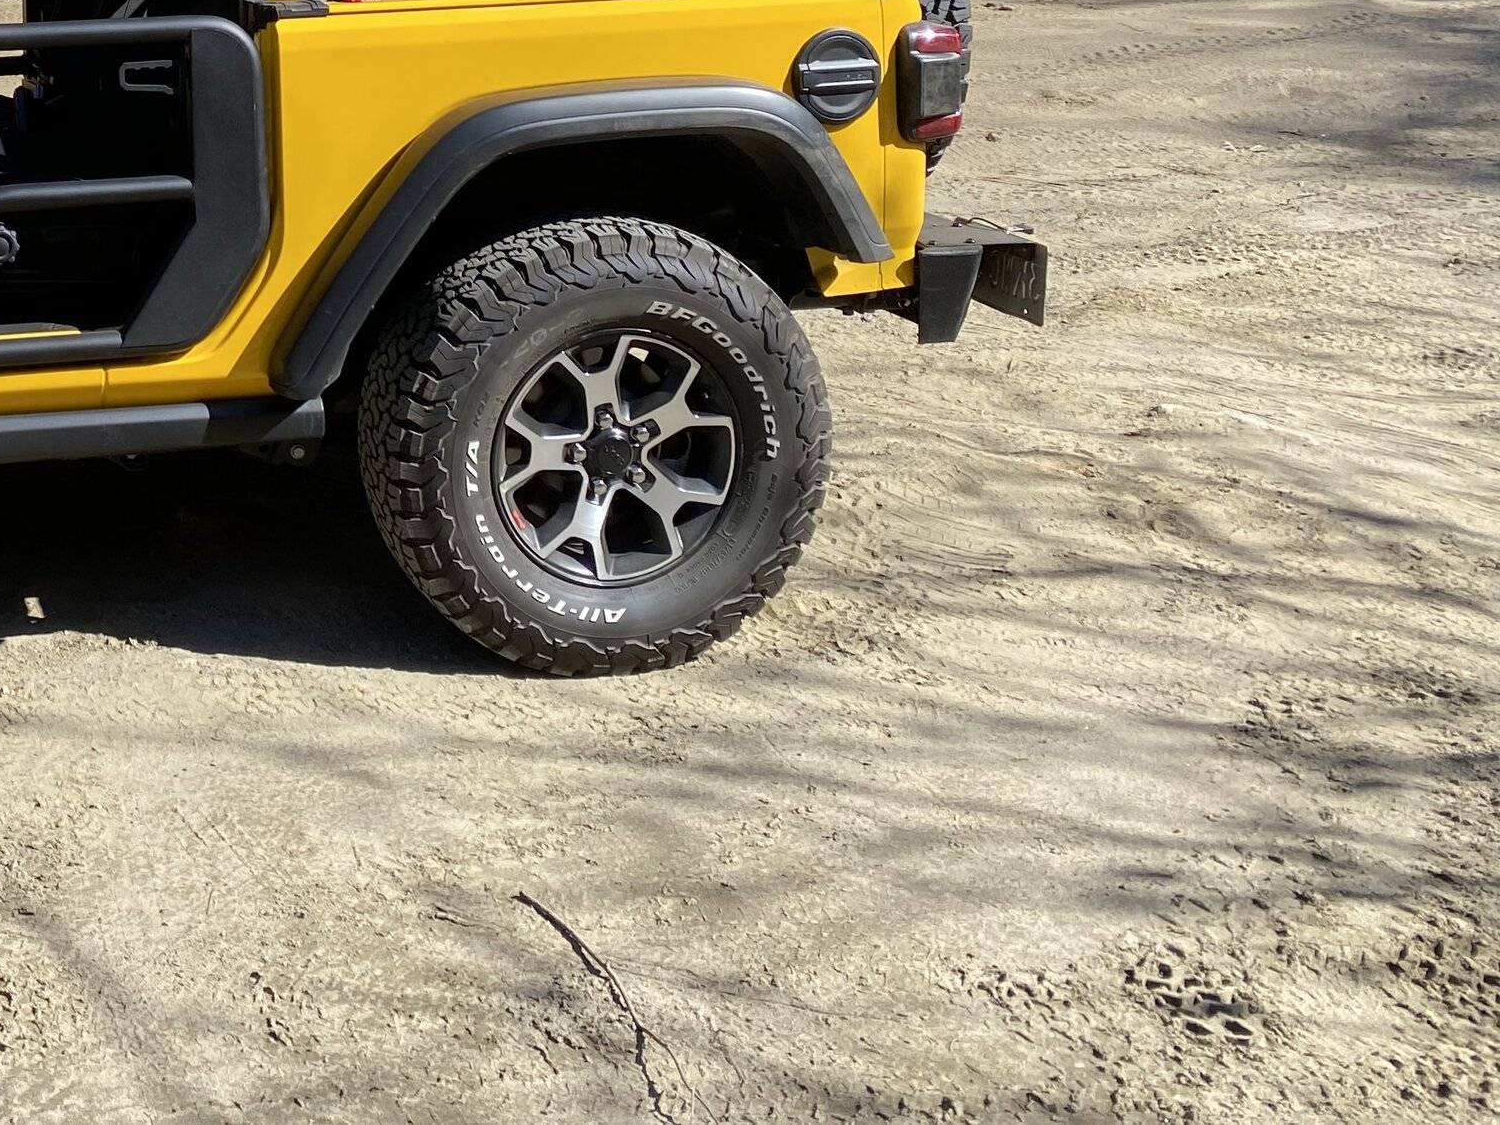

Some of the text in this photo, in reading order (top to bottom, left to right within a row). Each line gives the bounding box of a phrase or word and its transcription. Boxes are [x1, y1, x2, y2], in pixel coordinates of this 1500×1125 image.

[646, 300, 781, 460] BFGoodrich
[464, 440, 628, 625] All-Terrain T/A
